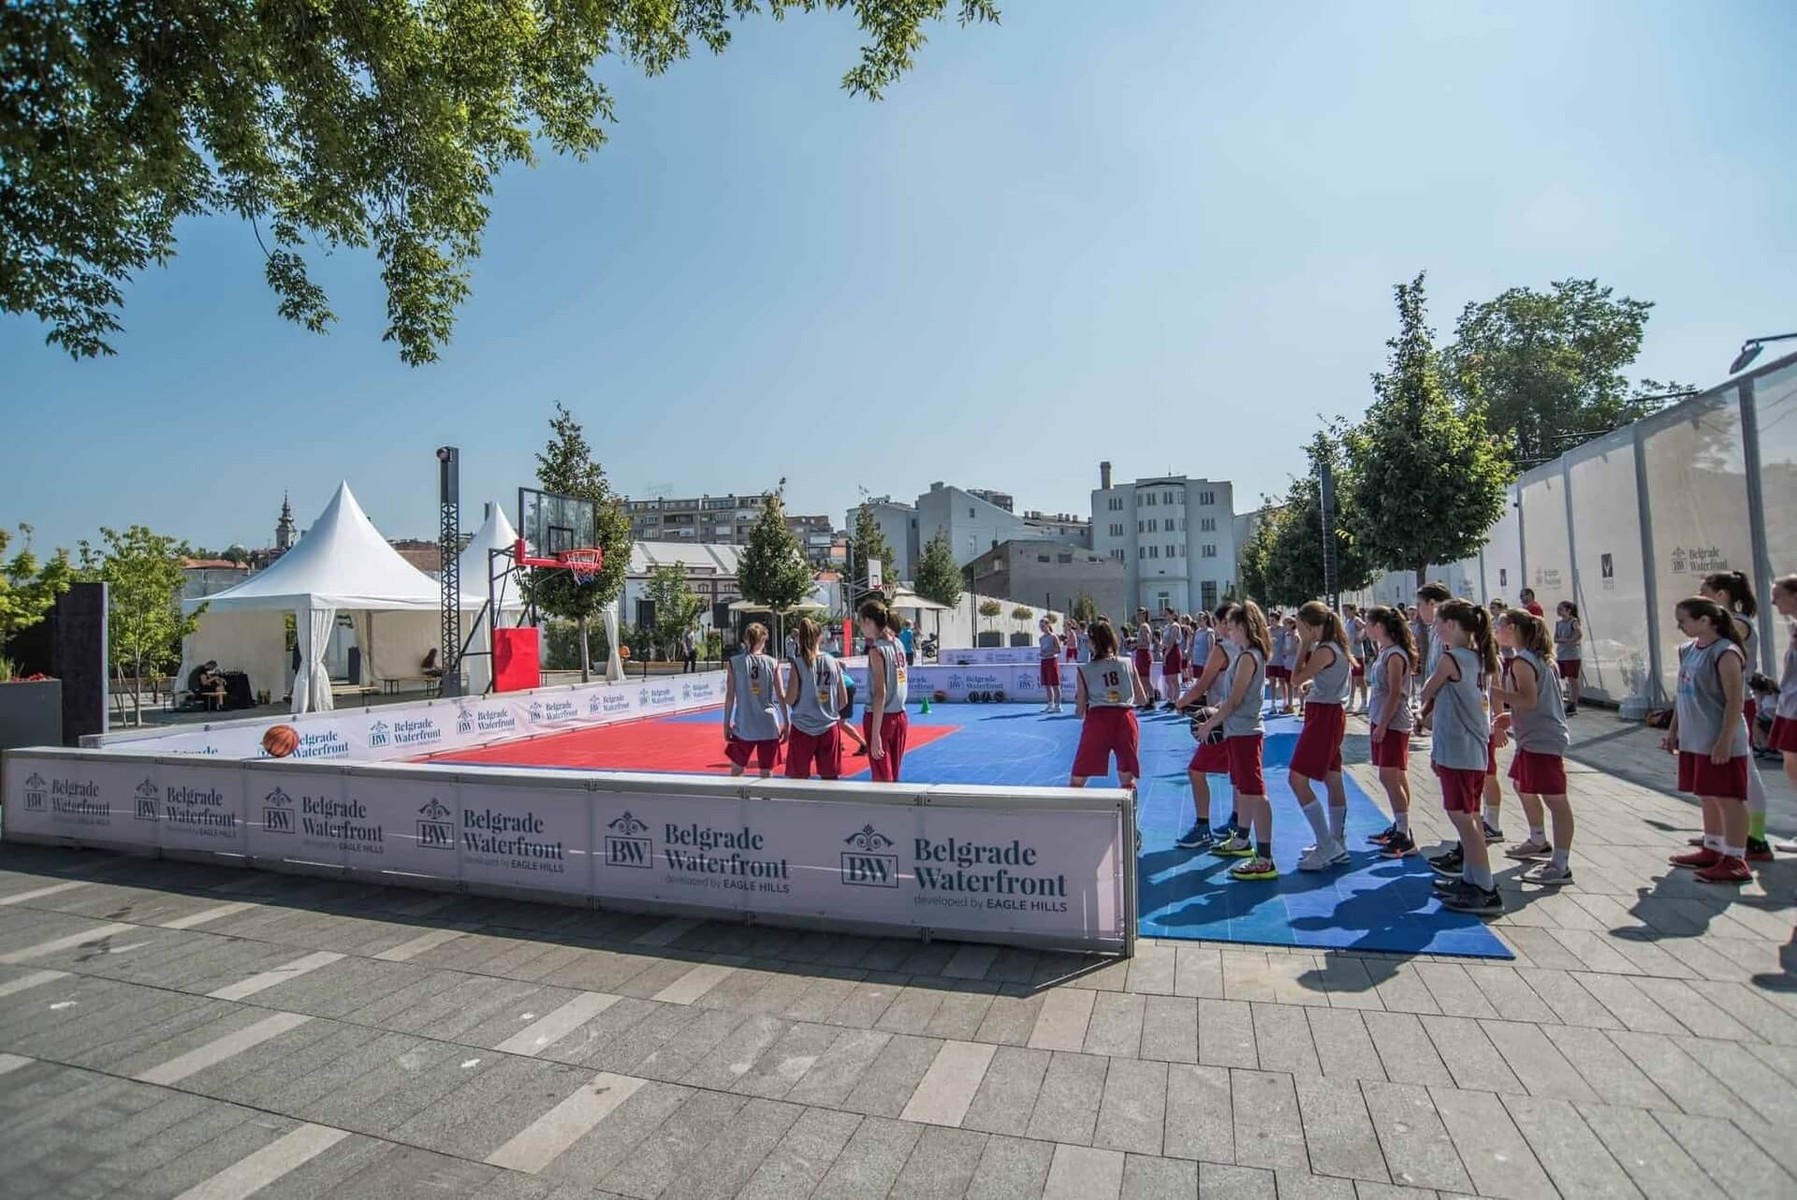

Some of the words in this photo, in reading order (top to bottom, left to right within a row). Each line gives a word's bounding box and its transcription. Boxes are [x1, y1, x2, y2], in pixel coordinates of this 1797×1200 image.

[751, 665, 759, 680] 3
[1102, 671, 1119, 687] 18
[394, 718, 433, 733] Belgrade
[299, 730, 338, 747] elgrade
[394, 729, 441, 744] Waterfront
[292, 742, 349, 759] Waterfront
[52, 778, 99, 798] Belgrade
[167, 786, 223, 807] Belgrade
[53, 797, 110, 816] Waterfront
[167, 806, 236, 827] Waterfront
[303, 796, 367, 819] Belgrade
[303, 817, 383, 842] Waterfront
[464, 809, 544, 834] Belgrade
[464, 832, 564, 860] Waterfront
[665, 823, 764, 850] Belgrade
[914, 838, 1037, 869] Belgrade
[511, 860, 538, 871] EAGLE
[540, 863, 564, 873] HILLS
[665, 849, 788, 879] Waterfront
[723, 879, 760, 891] EAGLE
[760, 882, 790, 893] HILLS
[914, 866, 1068, 897] Waterfront
[914, 895, 968, 908] developed
[971, 897, 983, 909] by
[987, 899, 1027, 911] EAGLE
[1031, 902, 1068, 913] HILLS
